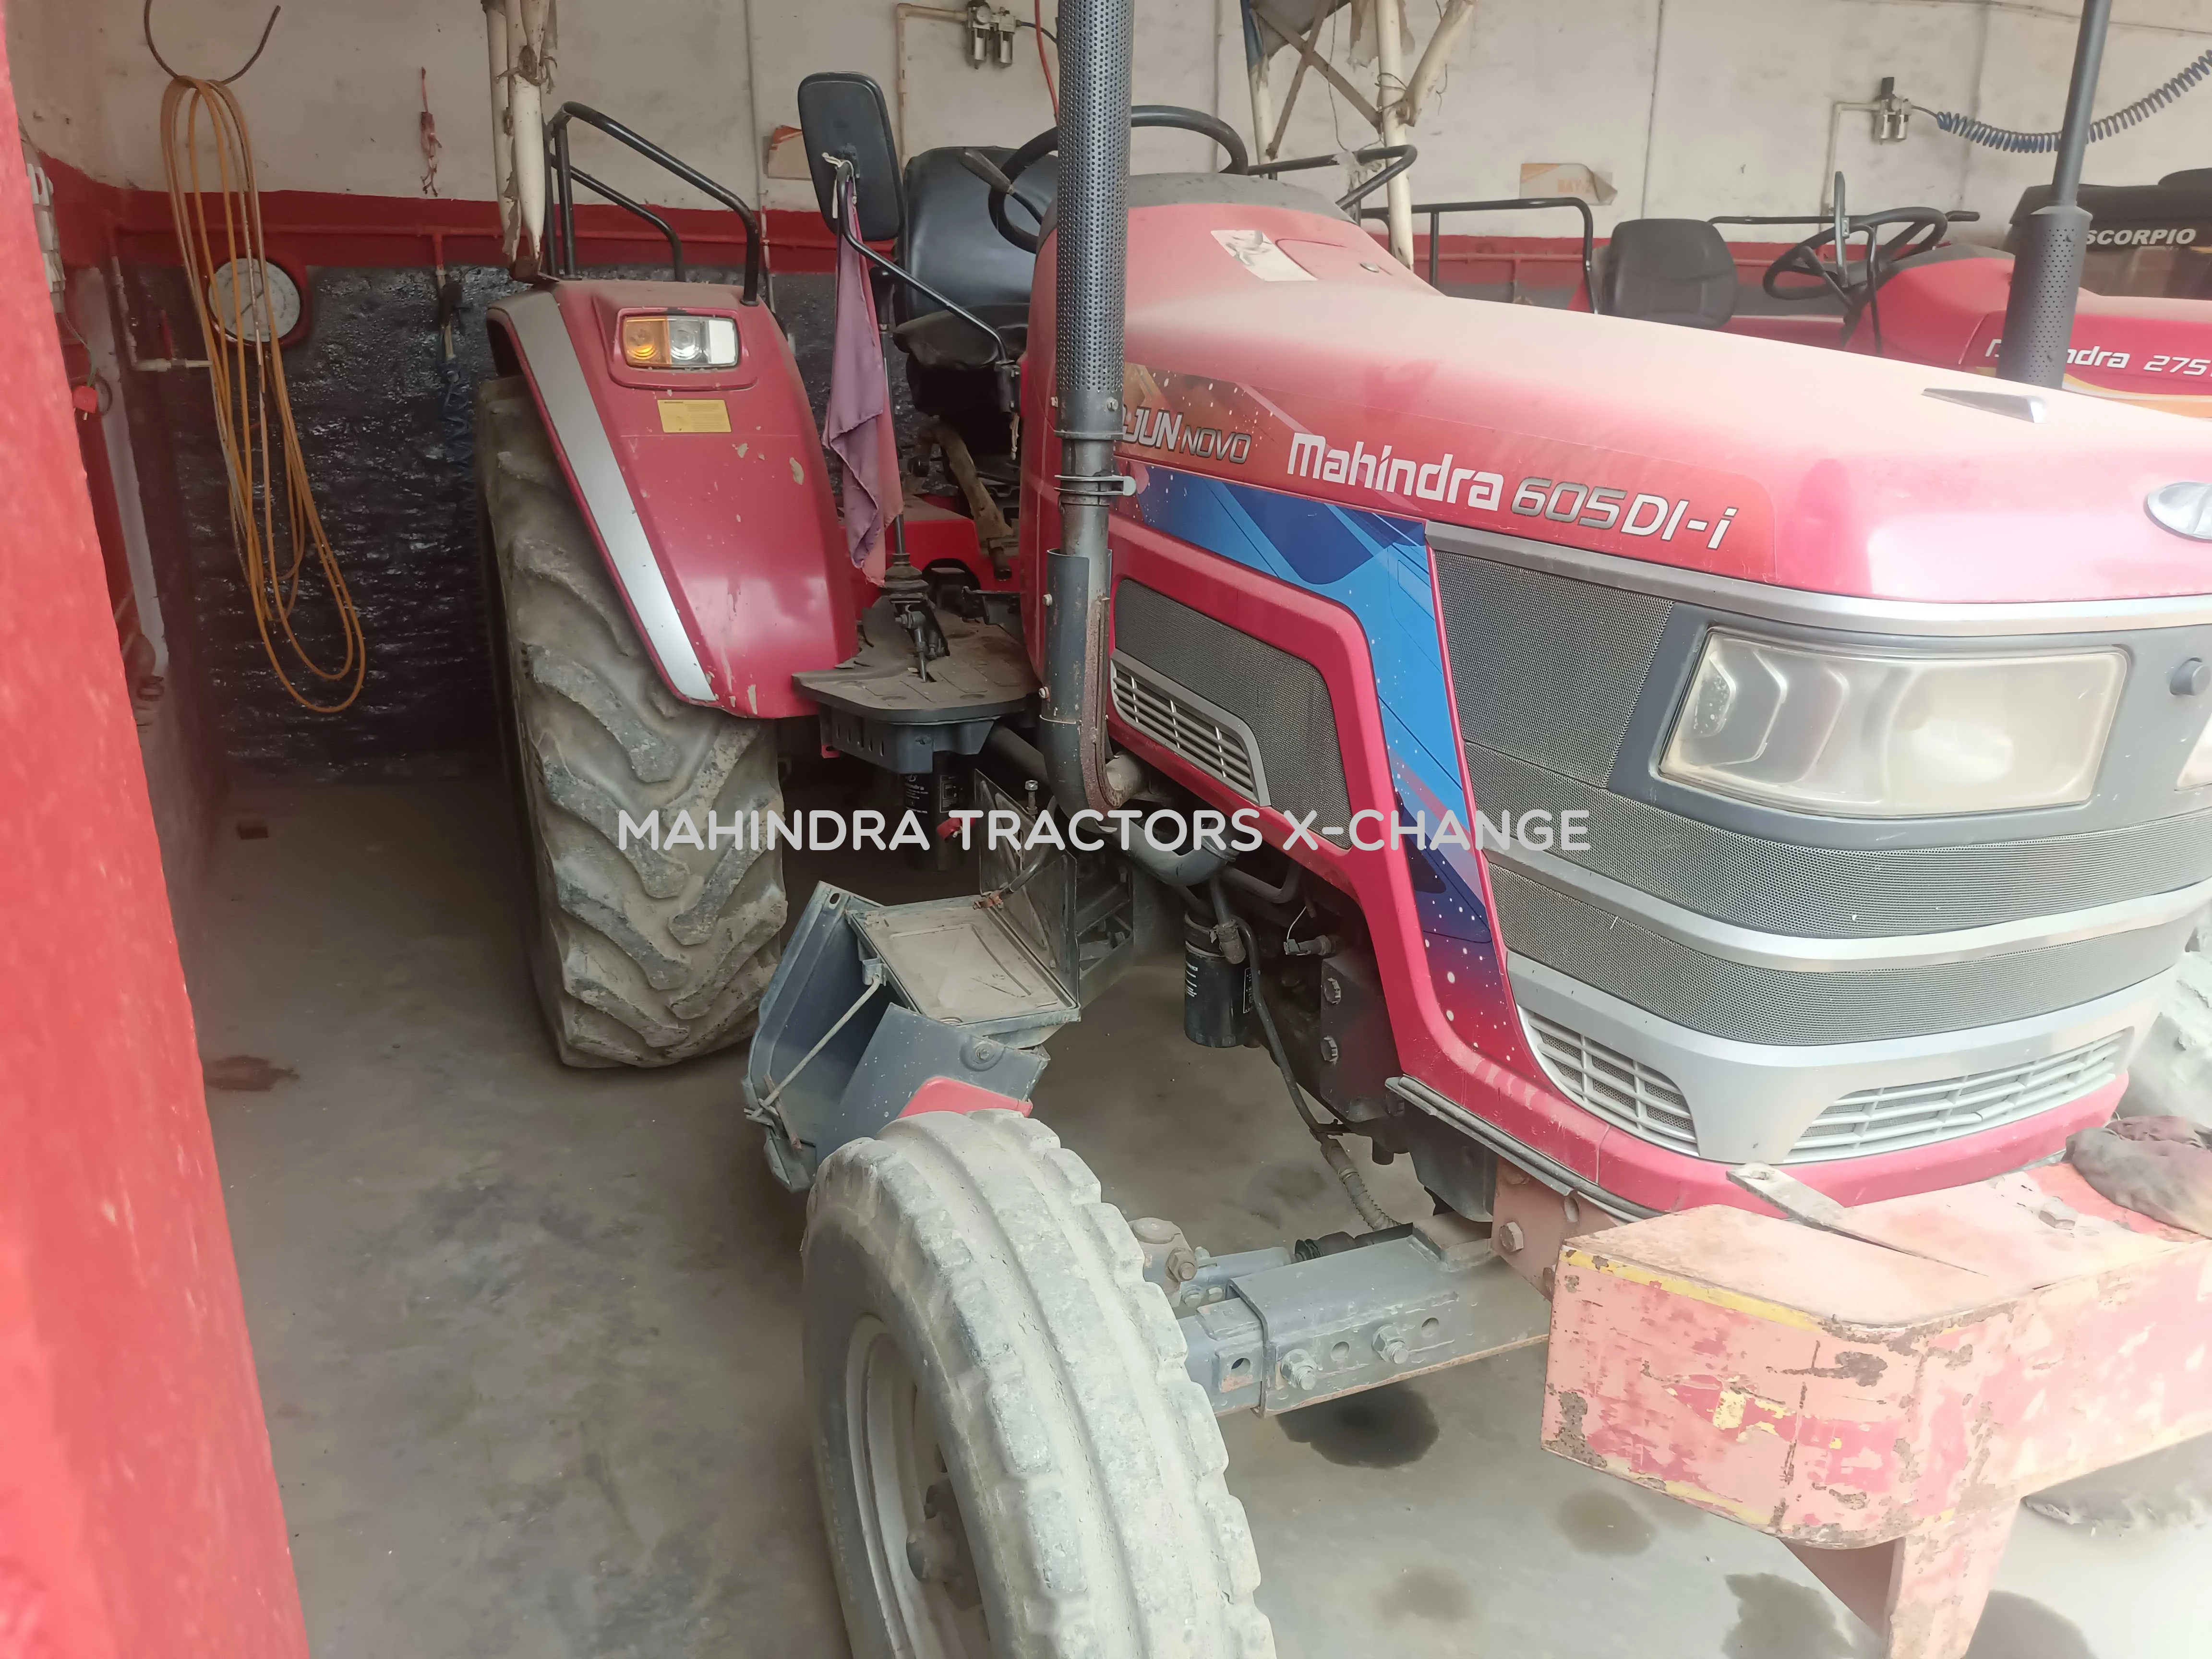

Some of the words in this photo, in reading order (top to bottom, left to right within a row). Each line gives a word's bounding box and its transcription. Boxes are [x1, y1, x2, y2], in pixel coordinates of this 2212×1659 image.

[2086, 228, 2197, 245] SCORPIO
[2143, 355, 2211, 375] 275
[1179, 424, 1251, 464] NOVO
[1287, 433, 1504, 511] Mahindra
